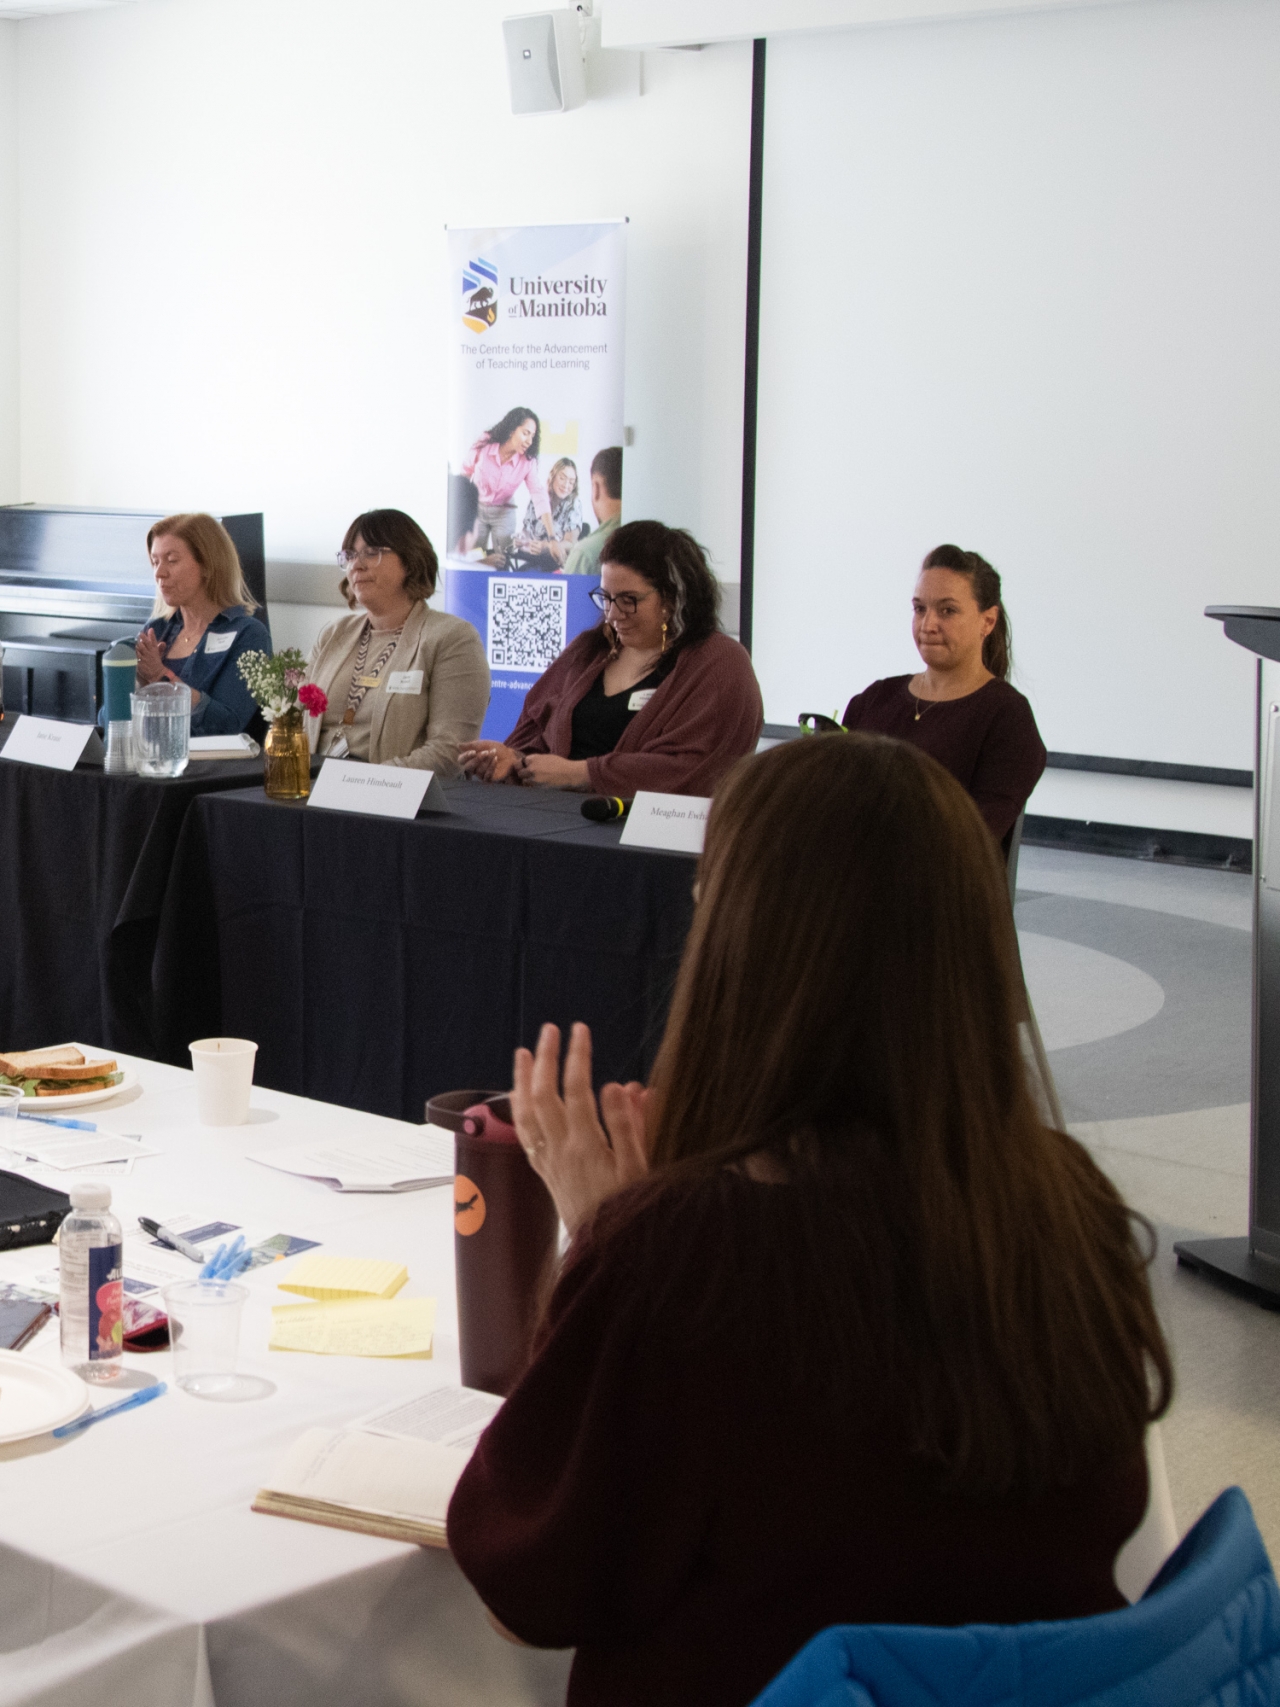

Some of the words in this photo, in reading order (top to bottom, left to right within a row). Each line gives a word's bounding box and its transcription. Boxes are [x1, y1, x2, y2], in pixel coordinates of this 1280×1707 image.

[509, 274, 608, 299] University
[508, 304, 518, 318] of
[519, 298, 608, 318] Manitoba
[461, 344, 477, 355] The
[479, 344, 510, 355] Centre
[512, 343, 524, 354] for
[526, 343, 541, 354] the
[543, 343, 608, 354] Advancement
[476, 358, 485, 369] of
[488, 358, 528, 371] Teaching
[530, 358, 548, 369] and
[550, 358, 590, 371] Learning
[342, 775, 366, 784] Lauren
[651, 807, 686, 820] Meaghan
